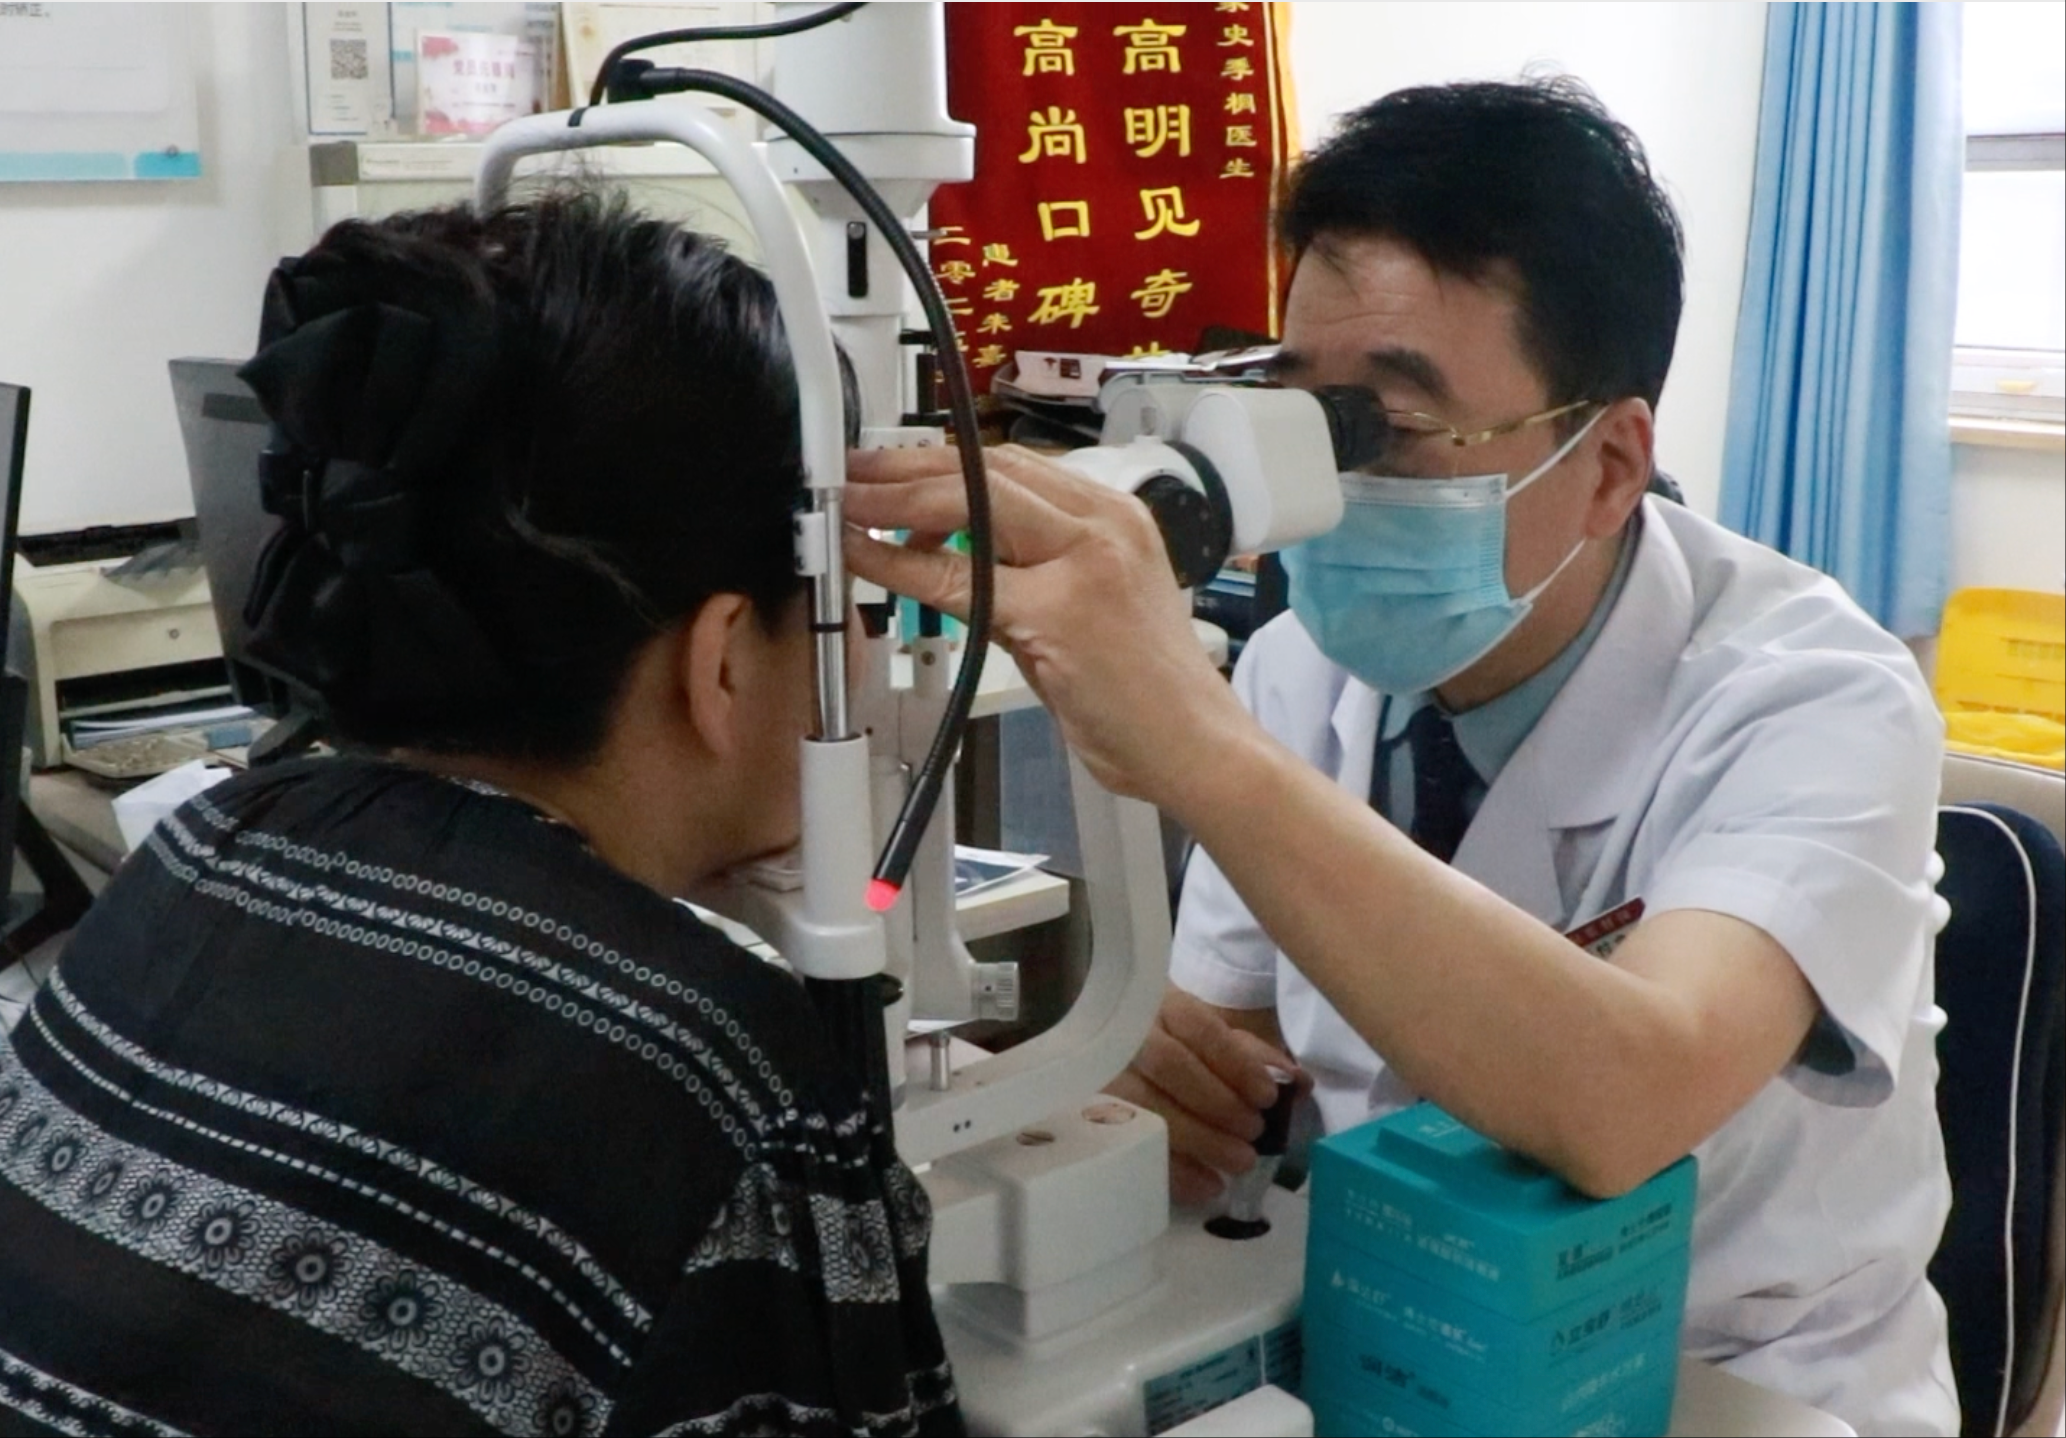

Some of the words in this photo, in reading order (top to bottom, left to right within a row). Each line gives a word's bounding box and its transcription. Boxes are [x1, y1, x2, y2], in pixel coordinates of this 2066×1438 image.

[1013, 18, 1101, 330] 高尚口碑
[1112, 18, 1201, 358] 高明见奇
